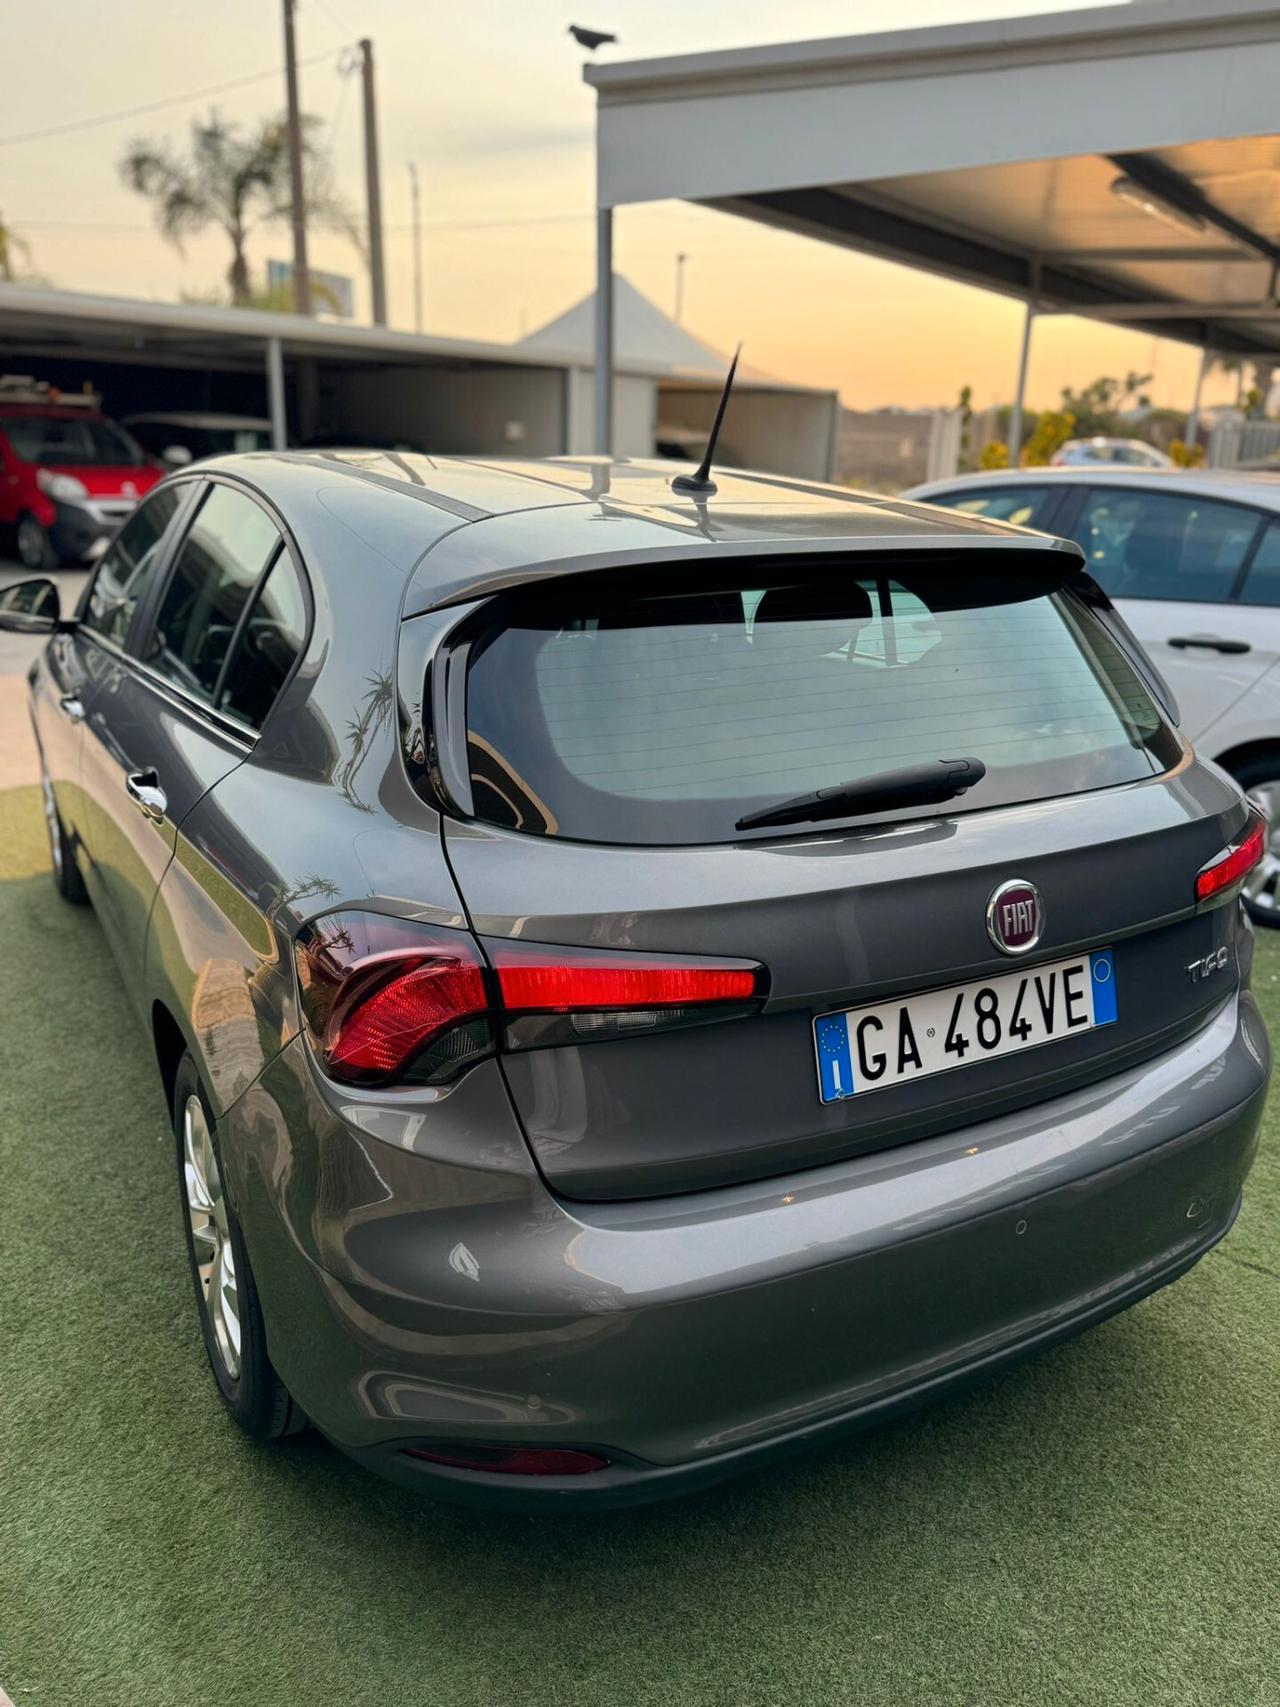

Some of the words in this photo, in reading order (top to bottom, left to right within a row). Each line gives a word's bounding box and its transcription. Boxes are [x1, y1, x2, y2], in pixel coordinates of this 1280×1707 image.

[1003, 899, 1034, 937] FIAT
[856, 1006, 923, 1081] GA
[944, 964, 1088, 1058] 484VE
